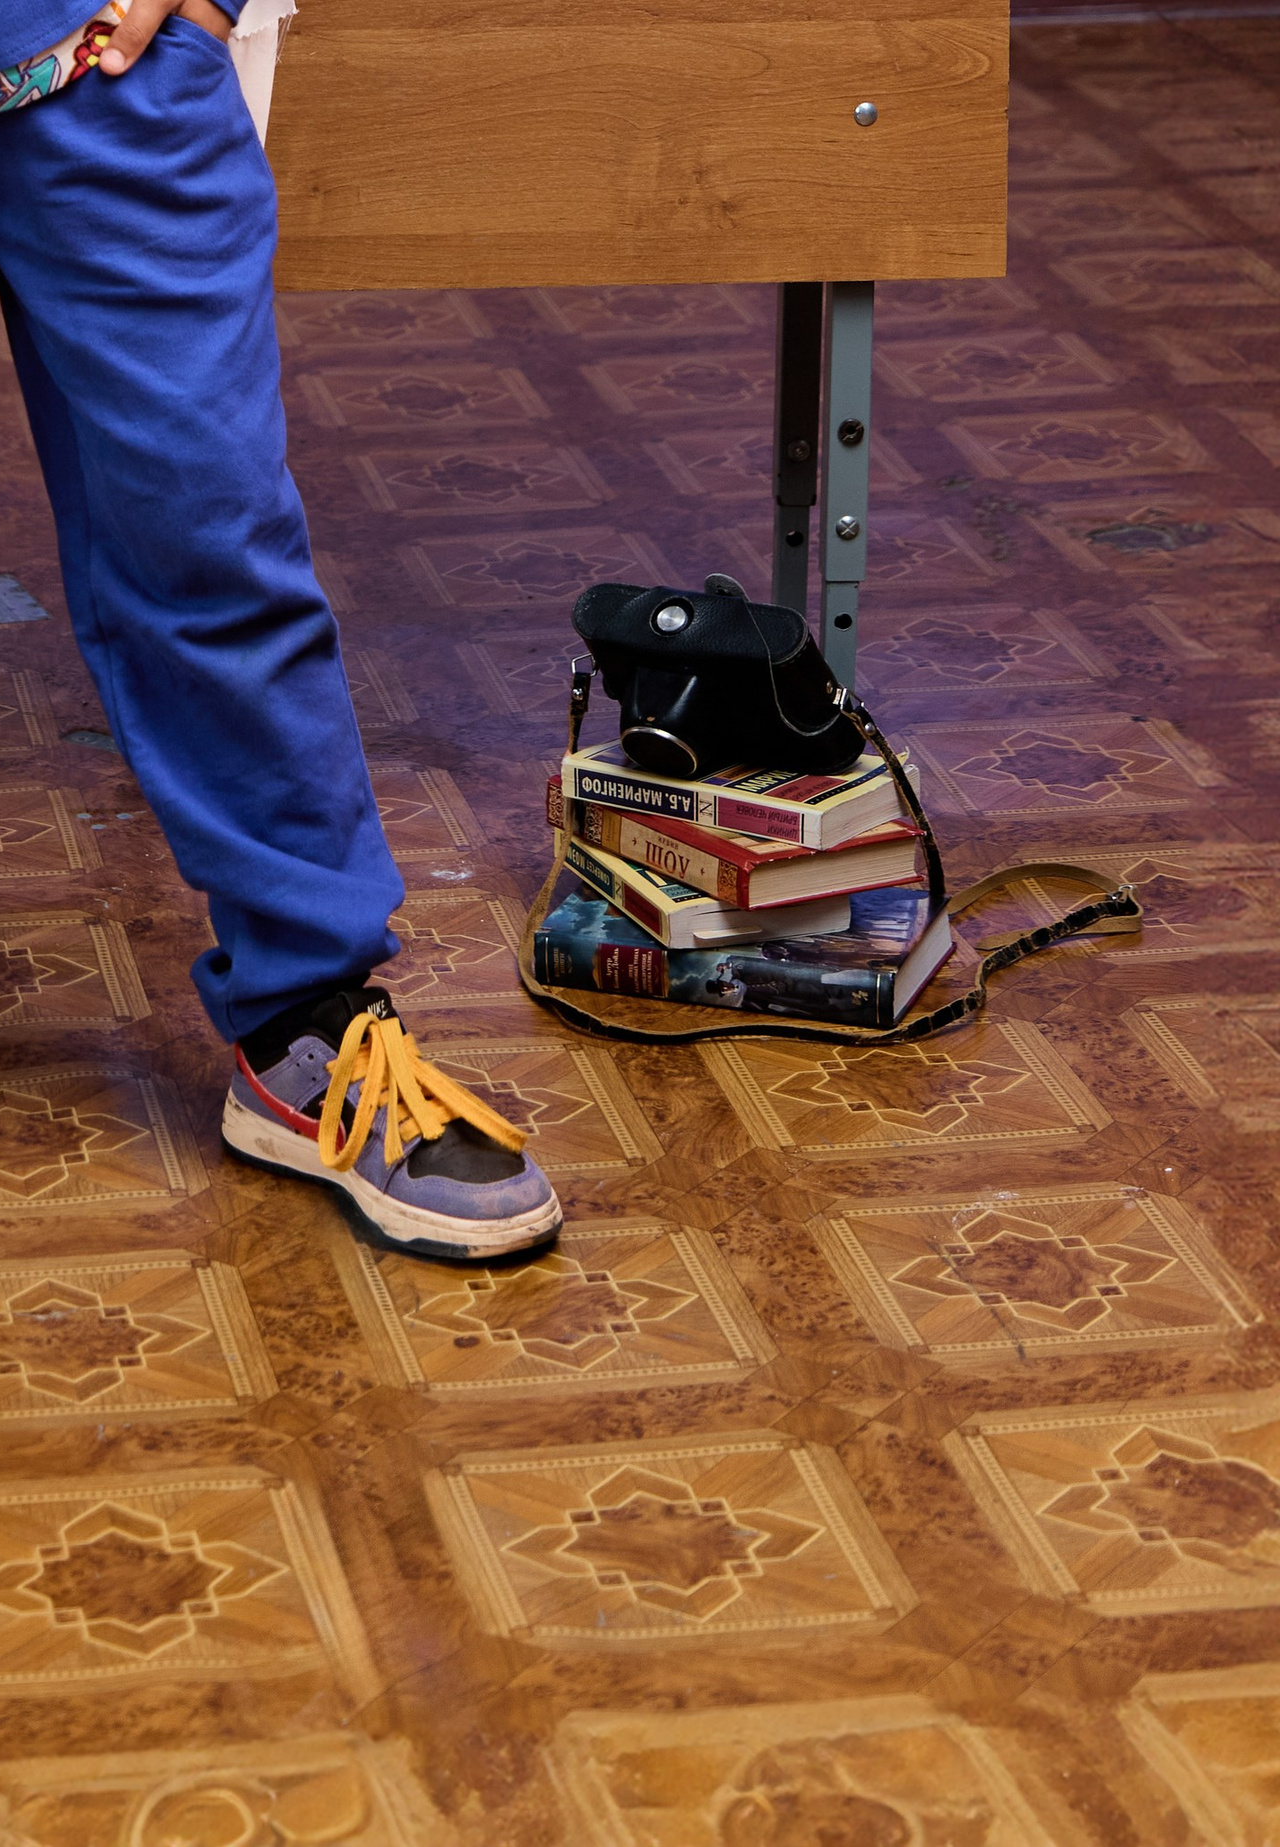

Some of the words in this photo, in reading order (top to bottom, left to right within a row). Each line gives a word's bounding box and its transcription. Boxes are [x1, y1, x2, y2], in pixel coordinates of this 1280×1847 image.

[581, 776, 663, 808] МАРИЕНГОФ
[665, 792, 691, 813] А.Б.
[735, 803, 767, 819] ЧЕЛОВЕК
[768, 812, 799, 827] БРИТЫЙ
[767, 824, 798, 839] ЦИНИКИ
[645, 840, 691, 879] ШОУ
[367, 999, 386, 1016] NIKE
